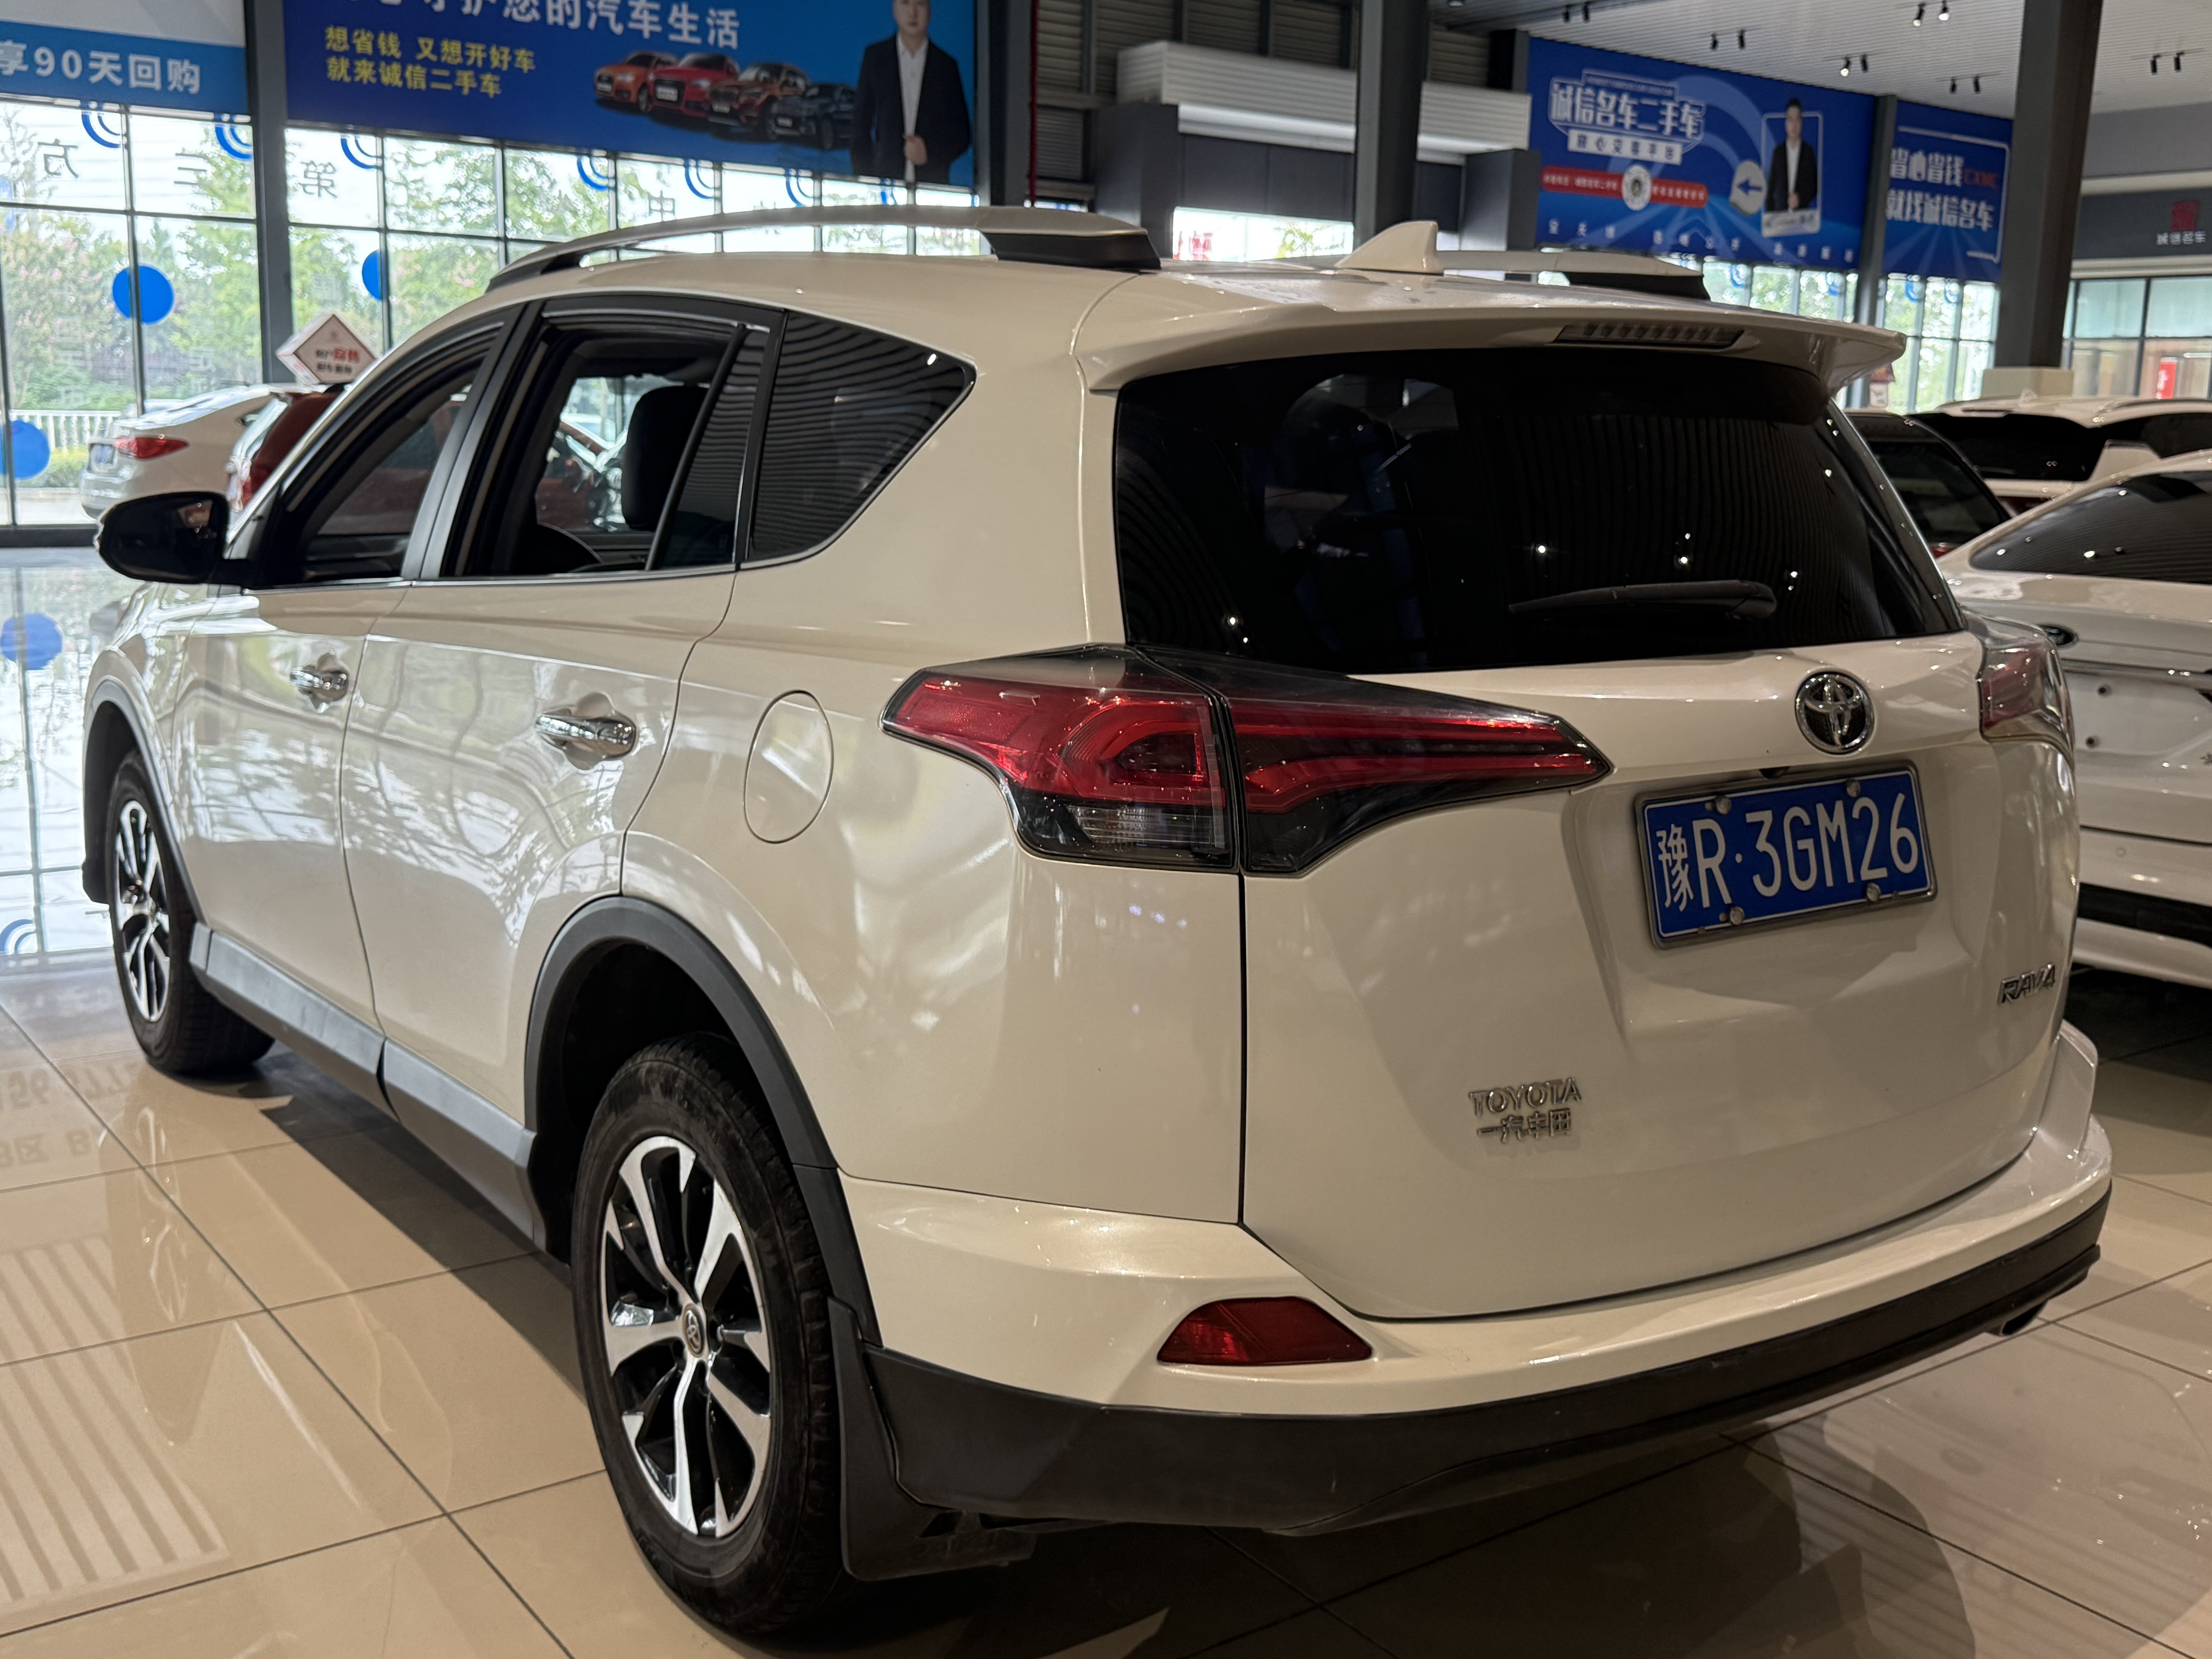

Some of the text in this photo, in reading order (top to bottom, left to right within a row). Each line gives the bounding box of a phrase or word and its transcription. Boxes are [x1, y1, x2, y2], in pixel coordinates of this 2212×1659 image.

[0, 40, 201, 94] 享90天回购
[325, 26, 536, 74] 想省钱 又想开好车
[325, 56, 502, 98] 就来诚信二手车
[1551, 81, 1701, 139] 诚信名车二手车
[1997, 963, 2055, 1006] RAV4
[1468, 1077, 1582, 1116] TOYOTA
